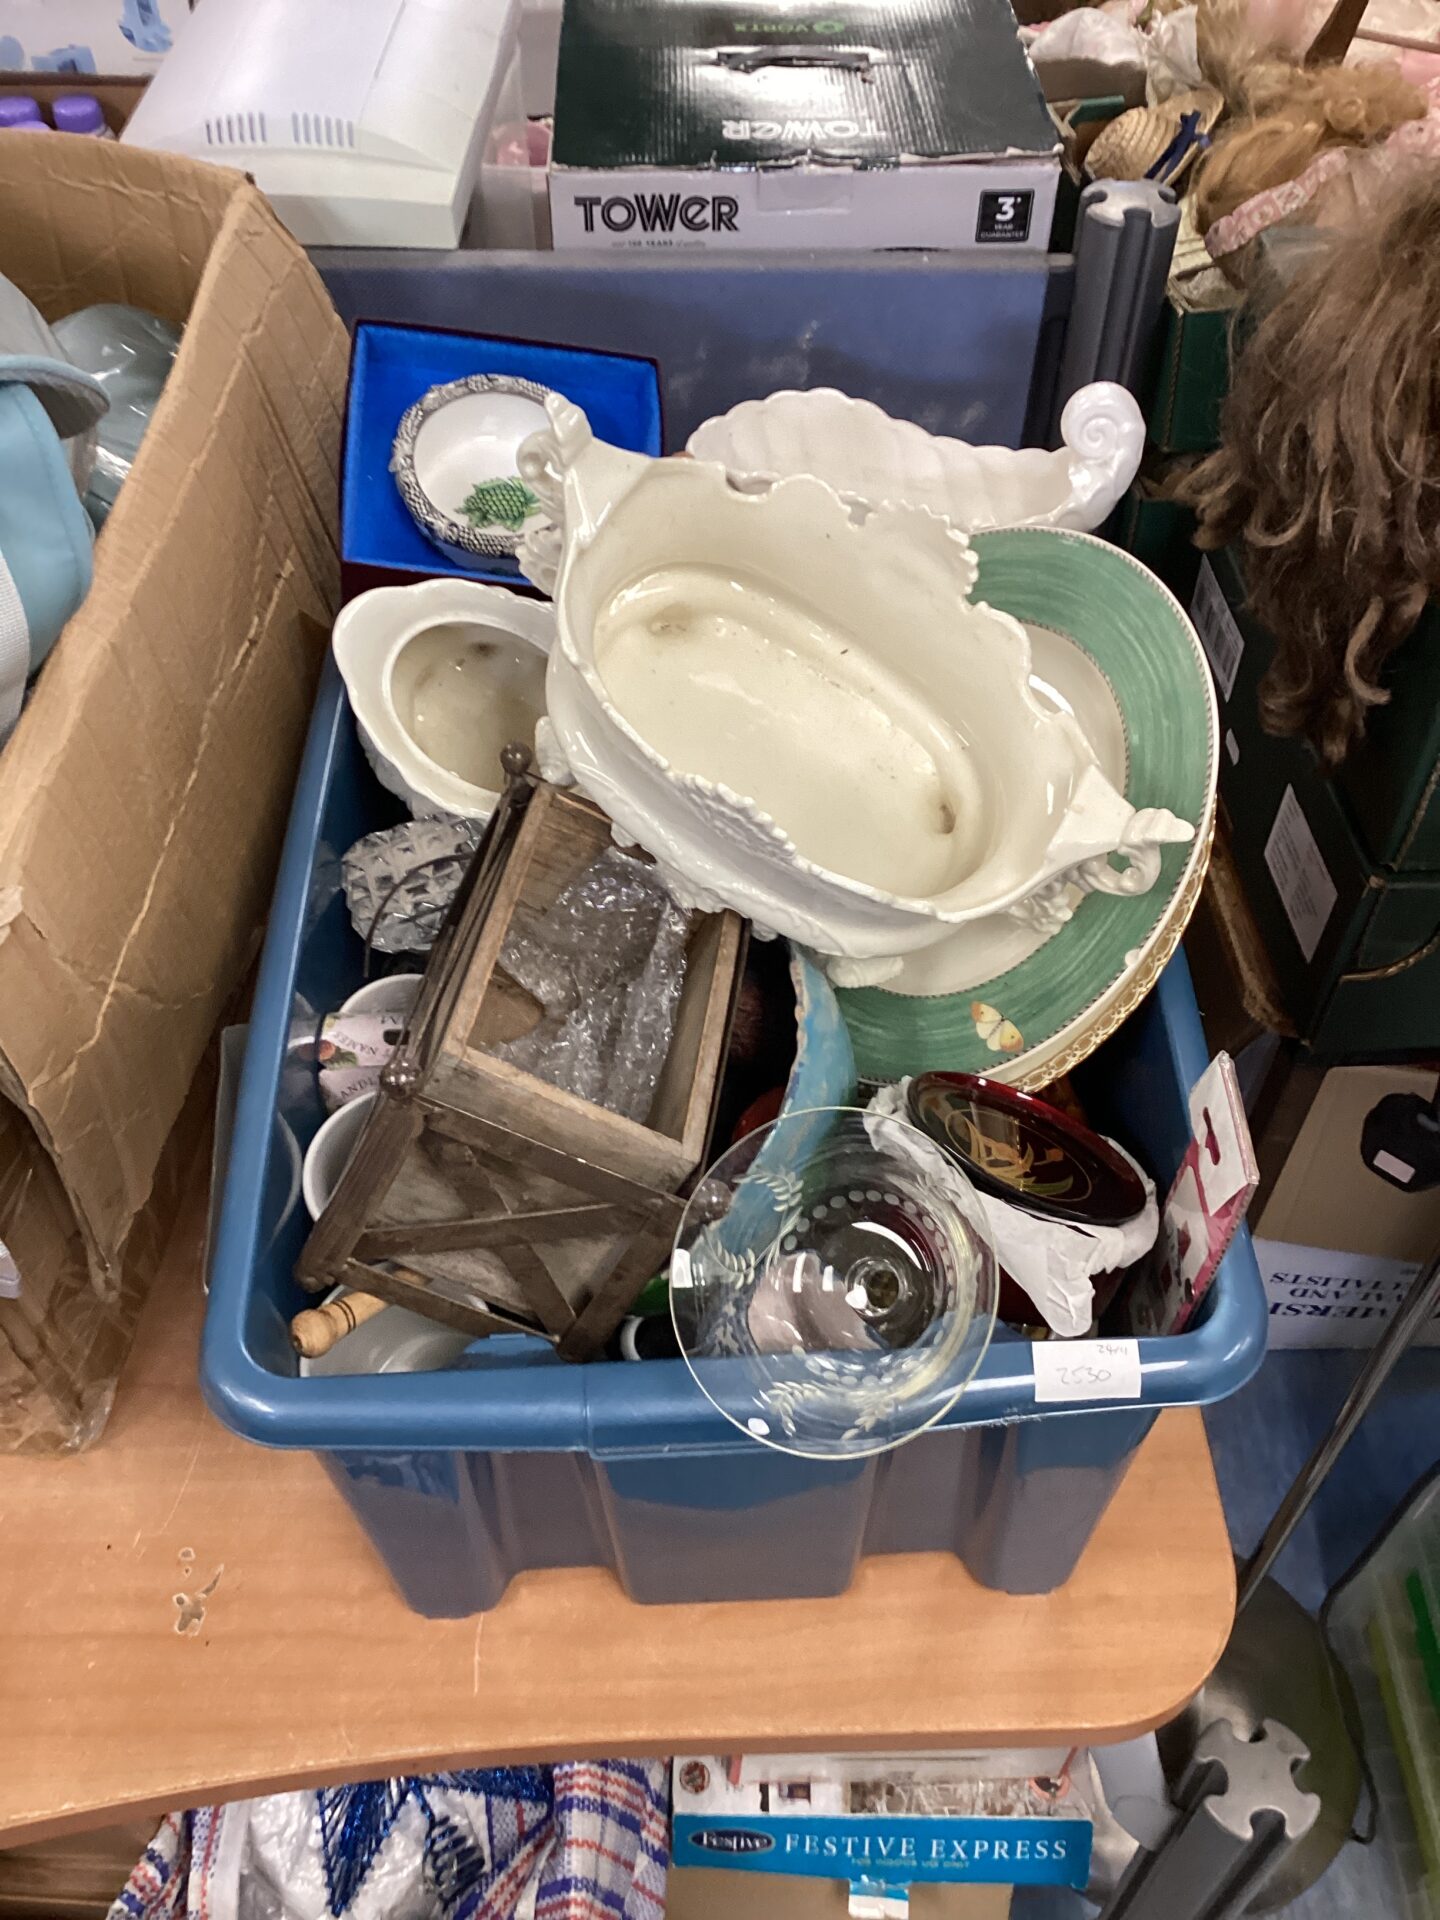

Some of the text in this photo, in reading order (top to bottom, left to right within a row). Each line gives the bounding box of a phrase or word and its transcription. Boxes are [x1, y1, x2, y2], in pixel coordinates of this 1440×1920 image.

[721, 118, 888, 143] TOWER
[574, 193, 740, 234] TOWER
[1288, 1287, 1344, 1300] AND
[1055, 1366, 1112, 1385] 2530
[785, 1833, 1068, 1860] FESTIVE EXPRESS
